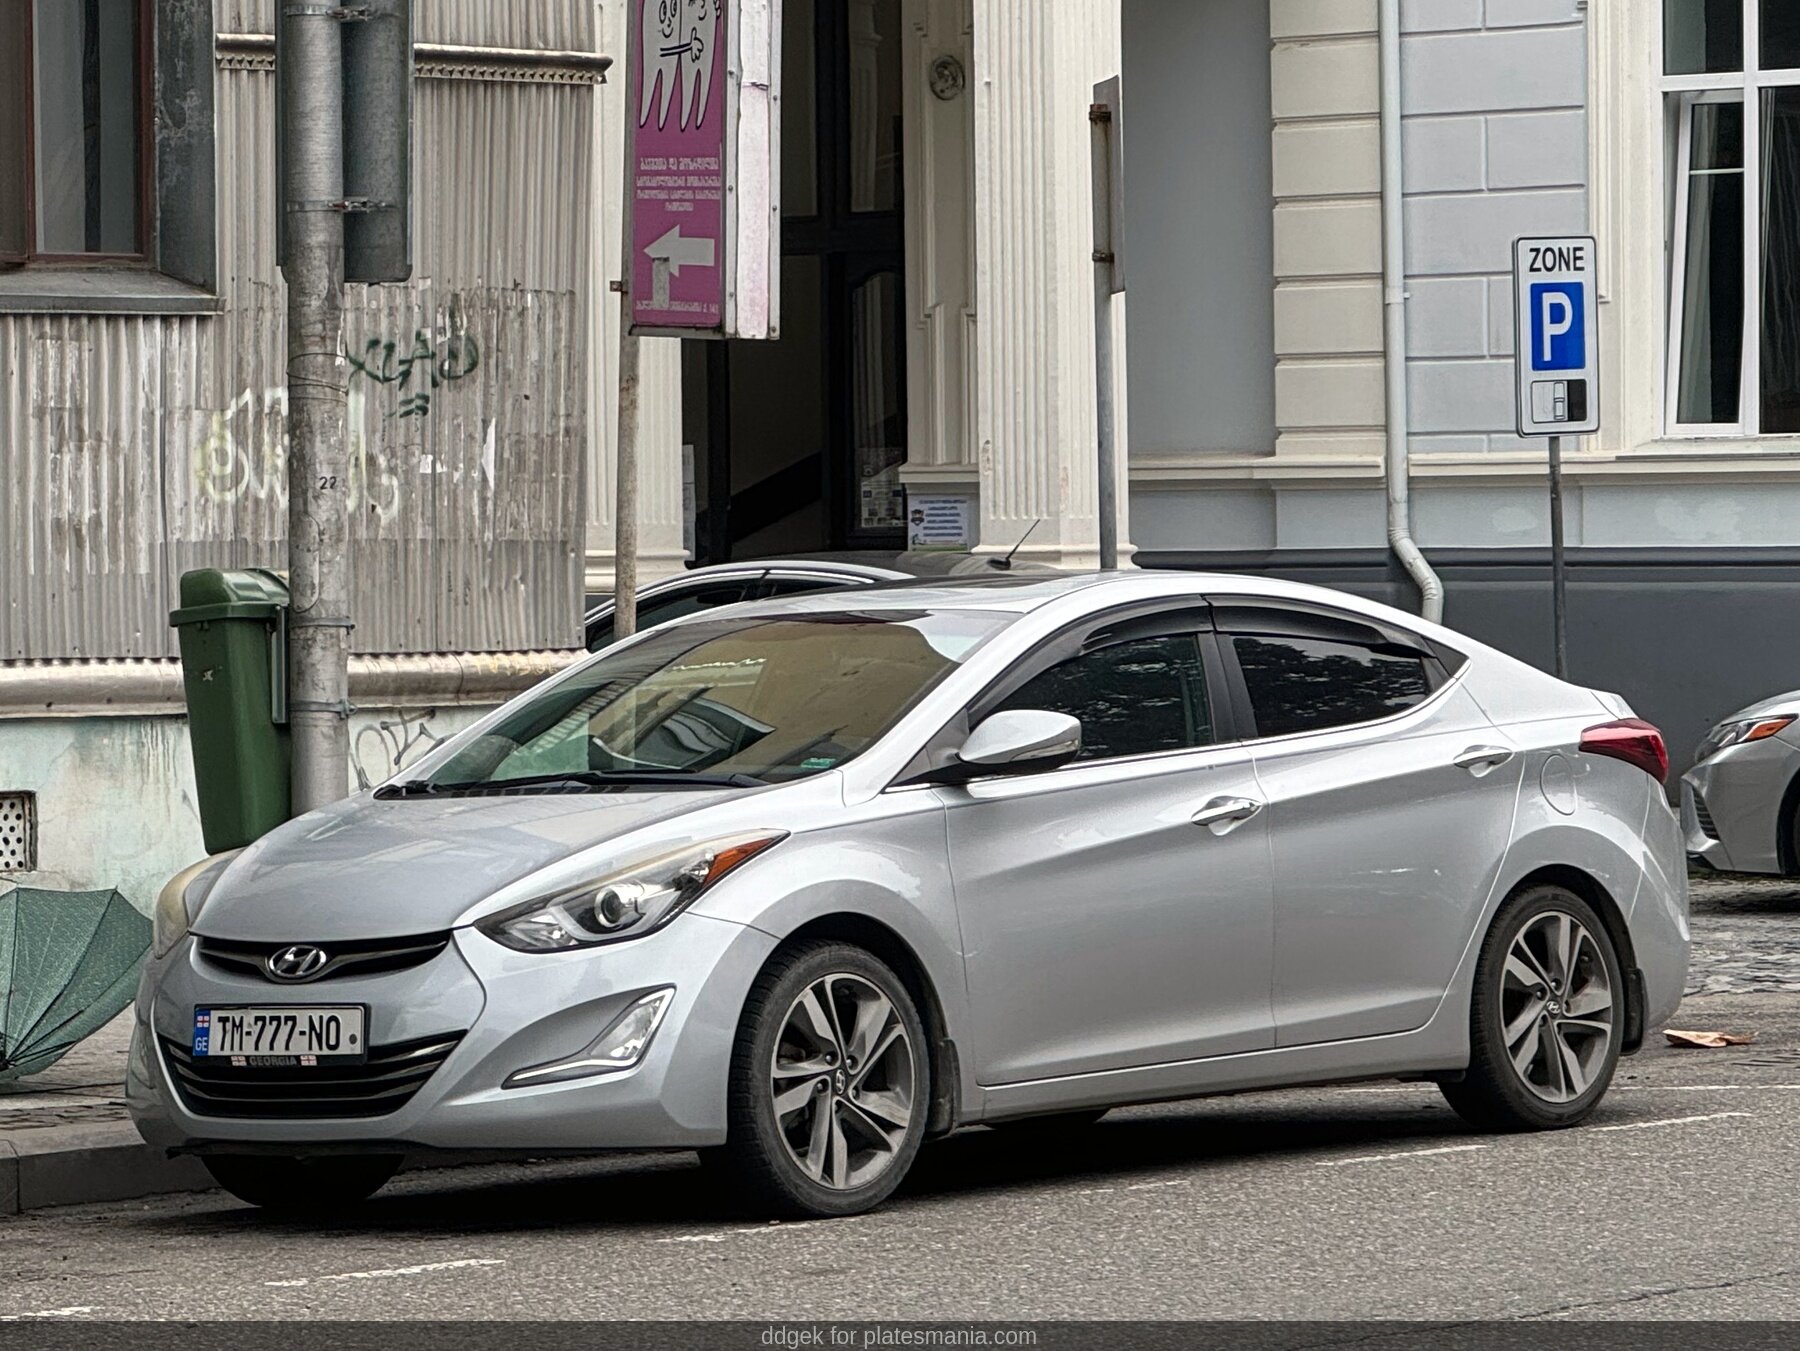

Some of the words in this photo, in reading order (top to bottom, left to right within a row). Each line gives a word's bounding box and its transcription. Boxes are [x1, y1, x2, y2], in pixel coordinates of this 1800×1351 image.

[1529, 247, 1585, 272] ZONE
[1542, 292, 1573, 362] P
[320, 476, 337, 490] 22
[217, 1014, 341, 1052] TM-777-NO
[195, 1037, 208, 1051] GE
[250, 1055, 297, 1067] GEORGIA
